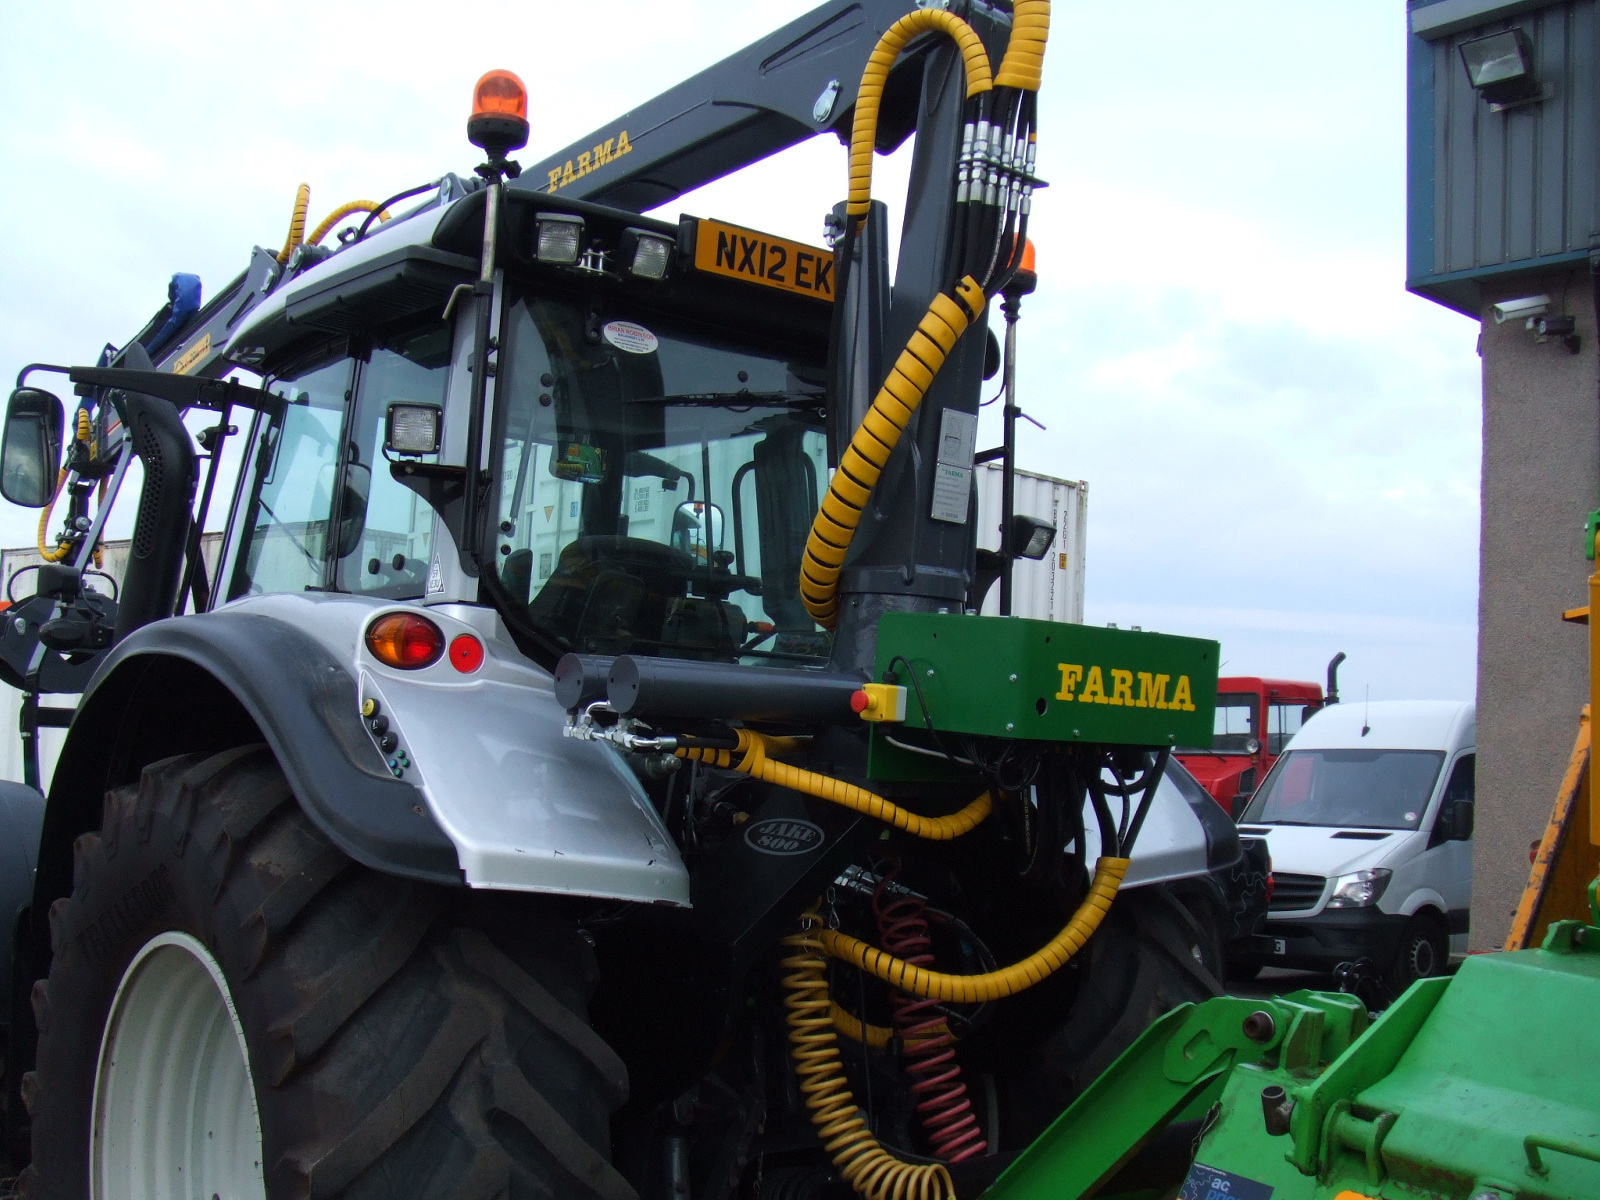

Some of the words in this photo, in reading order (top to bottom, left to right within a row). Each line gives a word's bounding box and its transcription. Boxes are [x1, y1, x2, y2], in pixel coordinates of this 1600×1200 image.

[547, 129, 633, 194] FARMA
[716, 230, 787, 282] NX12
[1055, 662, 1196, 712] FARMA
[759, 823, 816, 842] JAKE
[1211, 1178, 1231, 1192] ac
